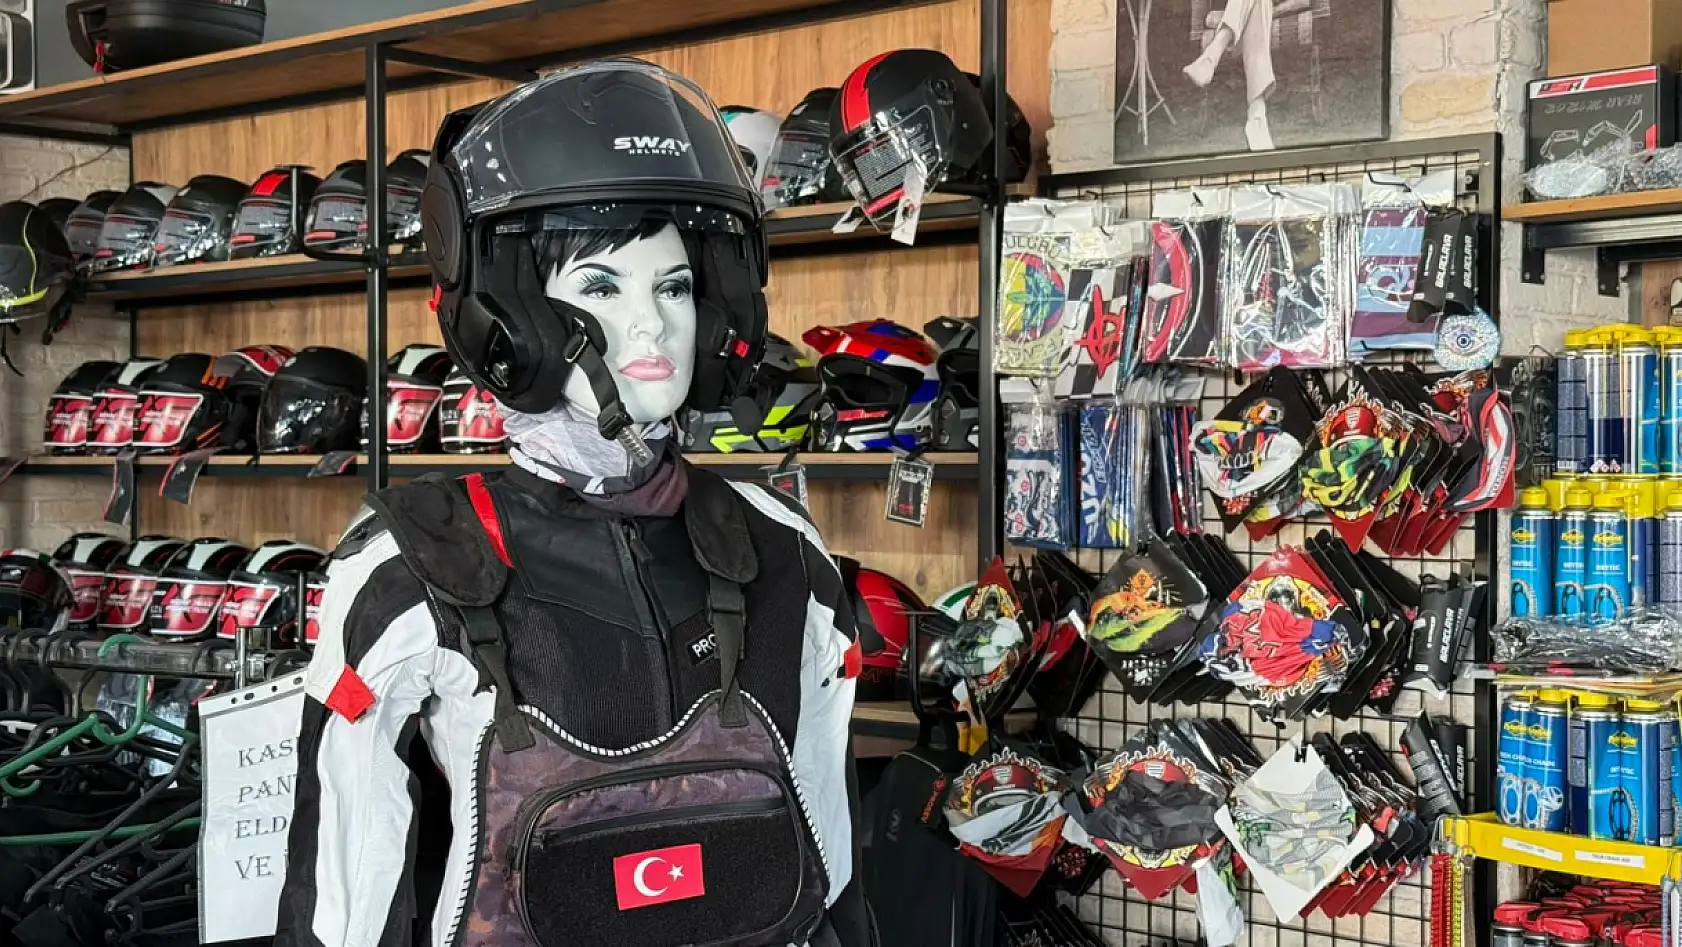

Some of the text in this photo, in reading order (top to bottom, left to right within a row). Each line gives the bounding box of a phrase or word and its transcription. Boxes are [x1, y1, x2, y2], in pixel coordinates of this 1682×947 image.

[613, 135, 691, 152] SWAY
[629, 148, 680, 156] HELMETS
[237, 774, 297, 804] PAN
[234, 853, 272, 880] VE
